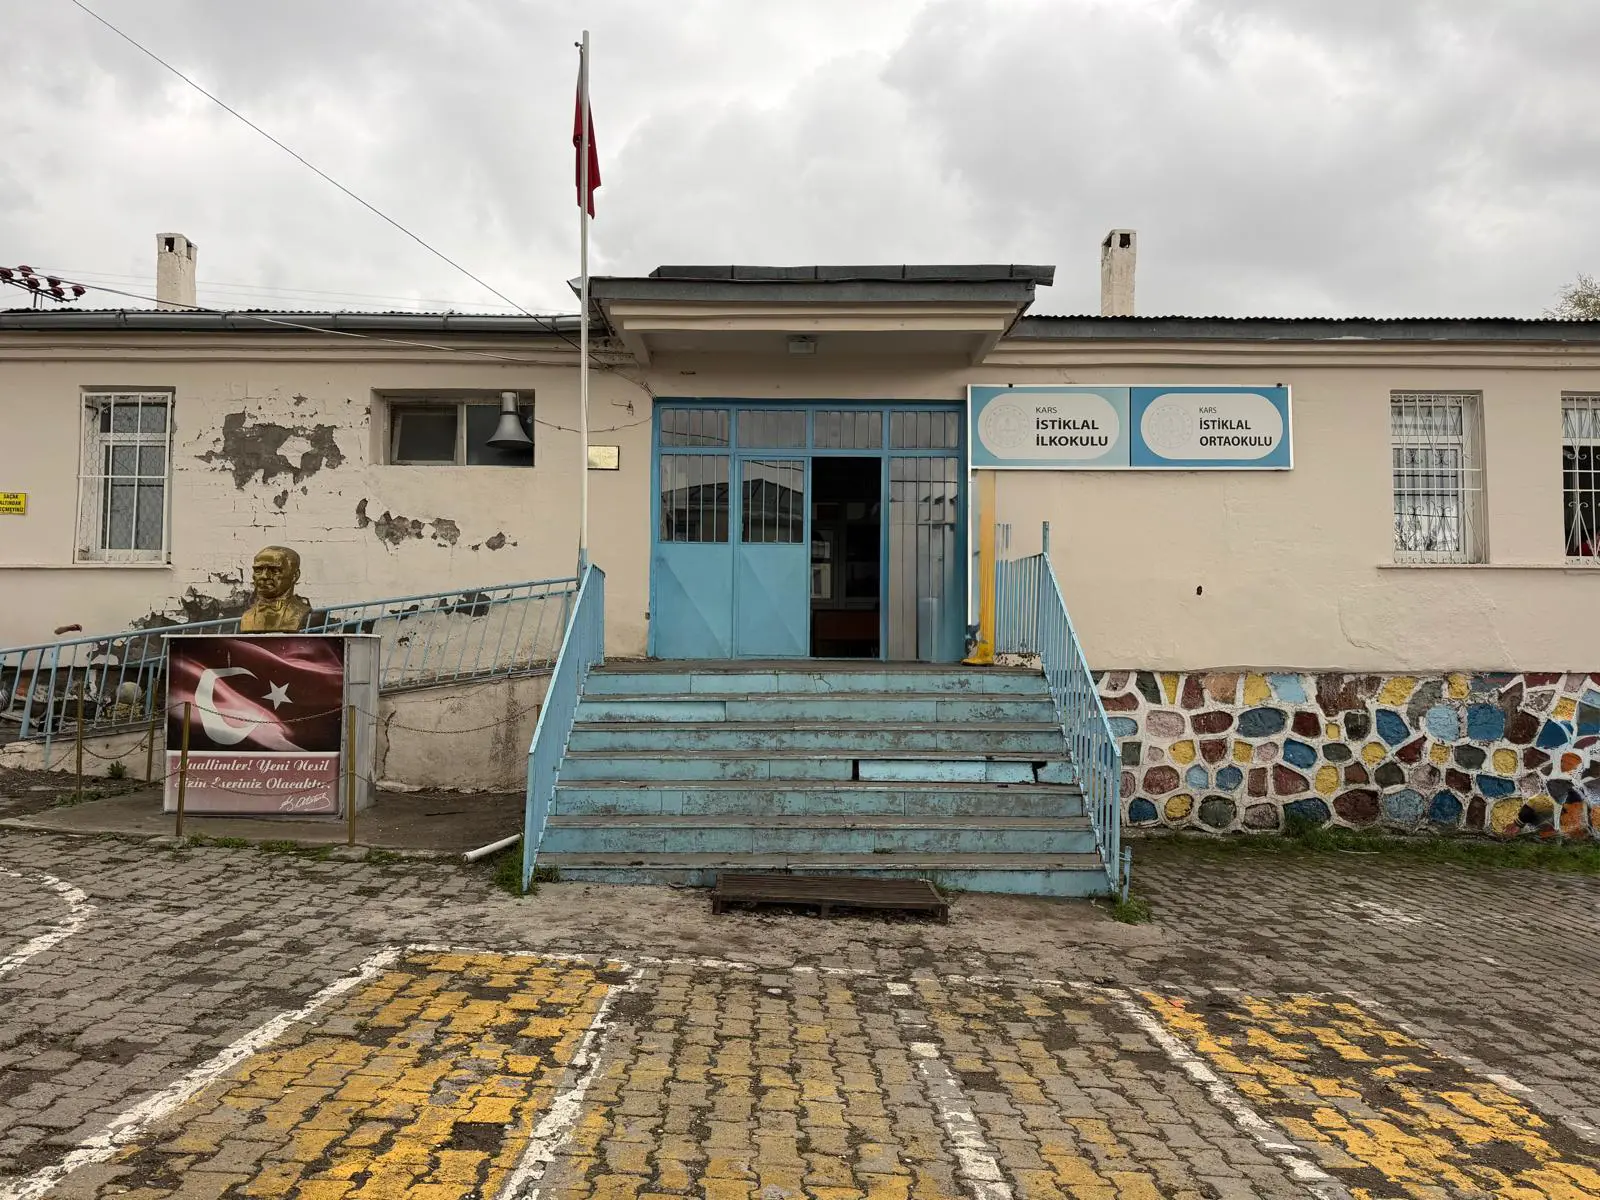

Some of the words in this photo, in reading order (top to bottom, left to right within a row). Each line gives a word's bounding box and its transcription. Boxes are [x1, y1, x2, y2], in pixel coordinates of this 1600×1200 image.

[1036, 406, 1058, 414] KARS
[1199, 406, 1217, 414] KARS
[1036, 417, 1100, 431] İSTİKLAL
[1199, 417, 1252, 431] İSTİKLAL
[1036, 433, 1109, 447] İLKOKULU
[1199, 436, 1273, 447] ORTAOKULU
[256, 759, 290, 774] Yeni
[293, 759, 330, 771] Nesil
[210, 776, 262, 789] Eseriniz
